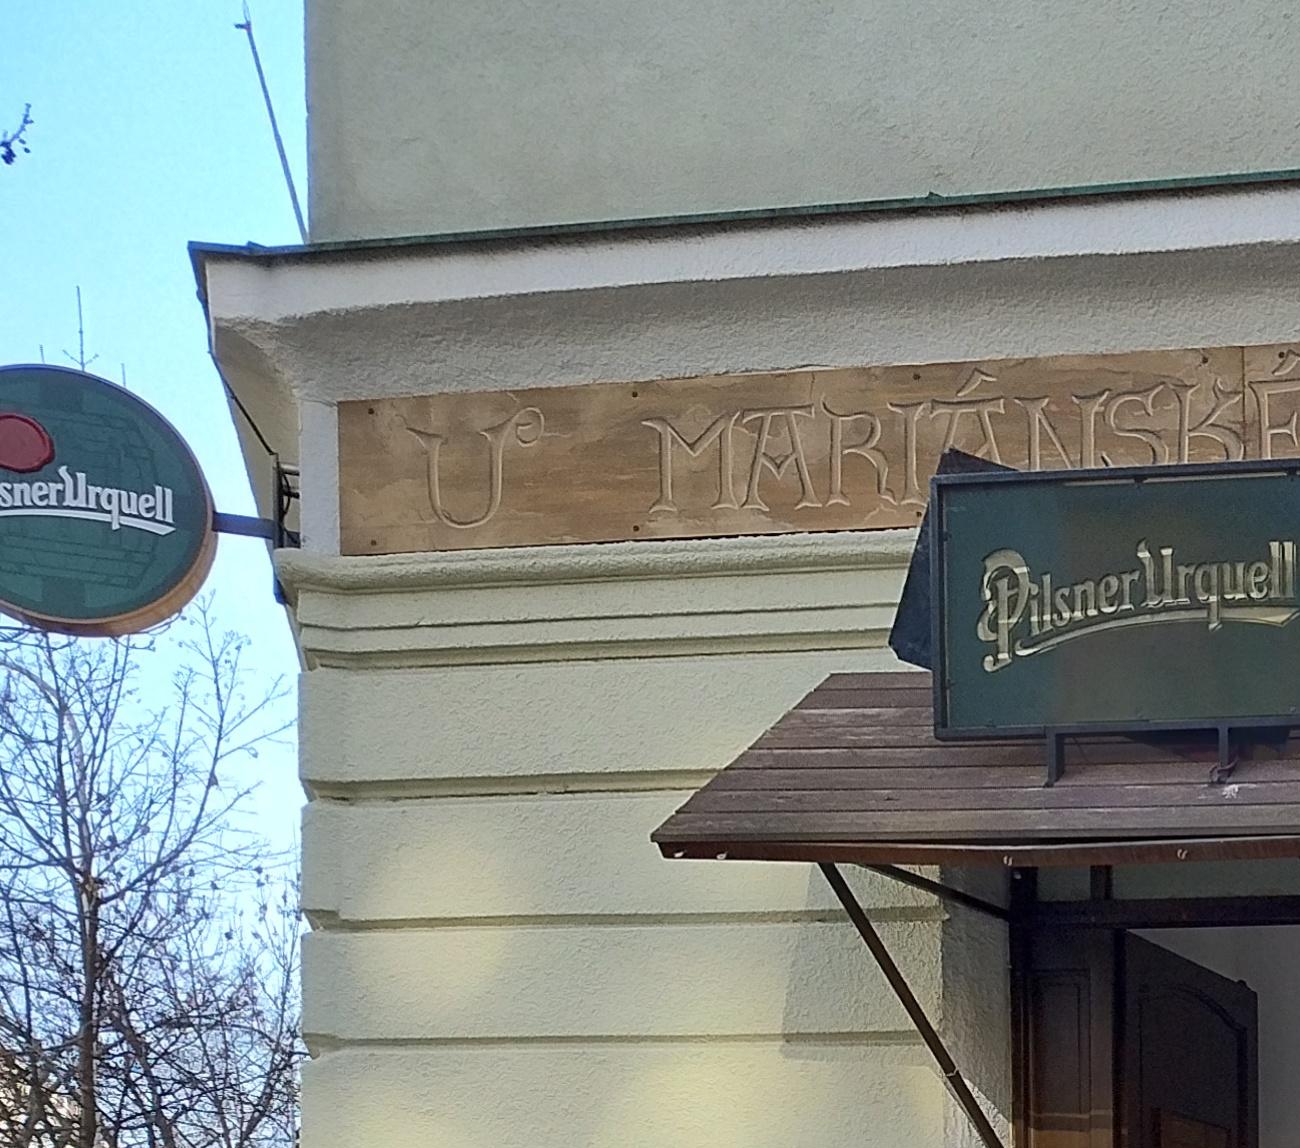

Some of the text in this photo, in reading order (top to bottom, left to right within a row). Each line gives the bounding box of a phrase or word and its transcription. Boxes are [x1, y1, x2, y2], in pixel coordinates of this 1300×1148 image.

[0, 465, 175, 532] sner Urquell
[977, 536, 1298, 674] Pilsner Urquell
